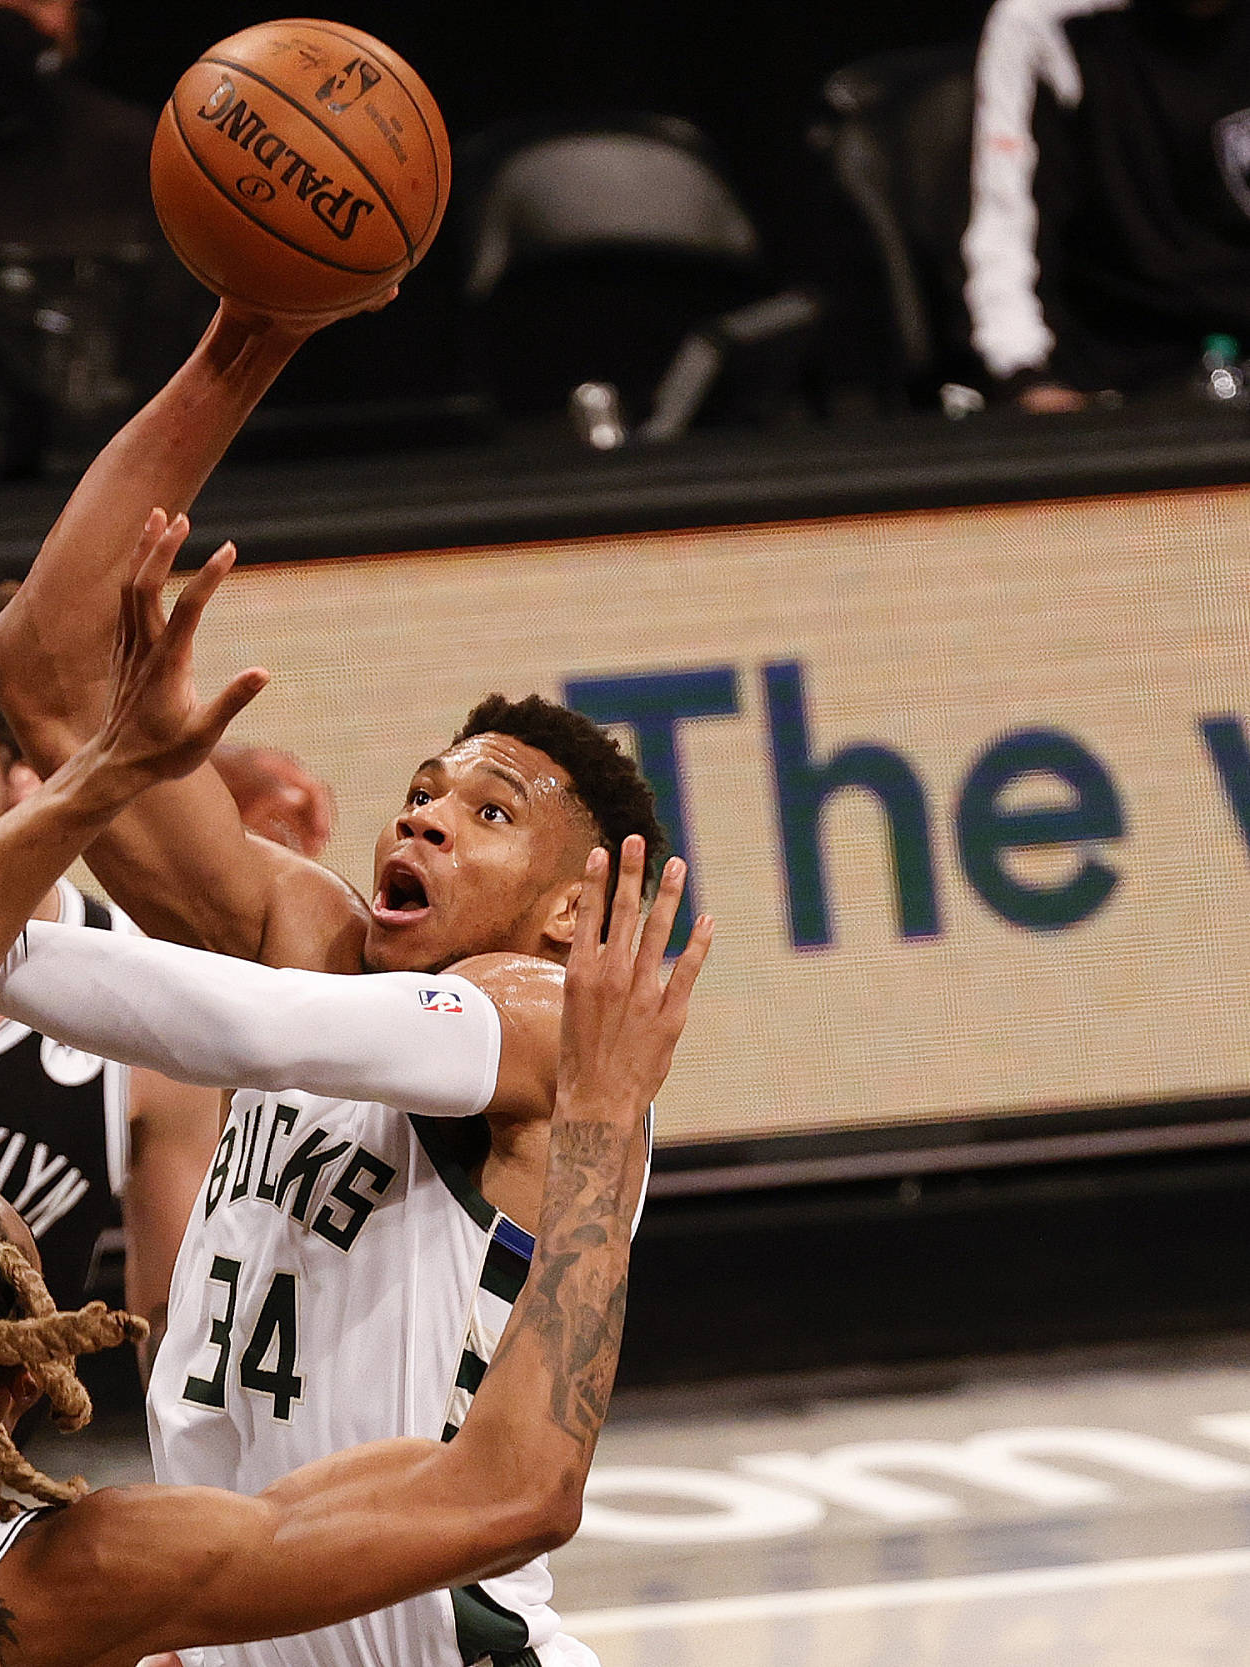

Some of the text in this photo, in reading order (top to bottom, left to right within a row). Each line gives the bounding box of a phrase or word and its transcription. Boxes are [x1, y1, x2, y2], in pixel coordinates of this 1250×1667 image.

[196, 73, 375, 240] SPALDING
[562, 656, 1126, 962] The
[203, 1102, 398, 1254] BUCKS
[179, 1254, 306, 1427] 34
